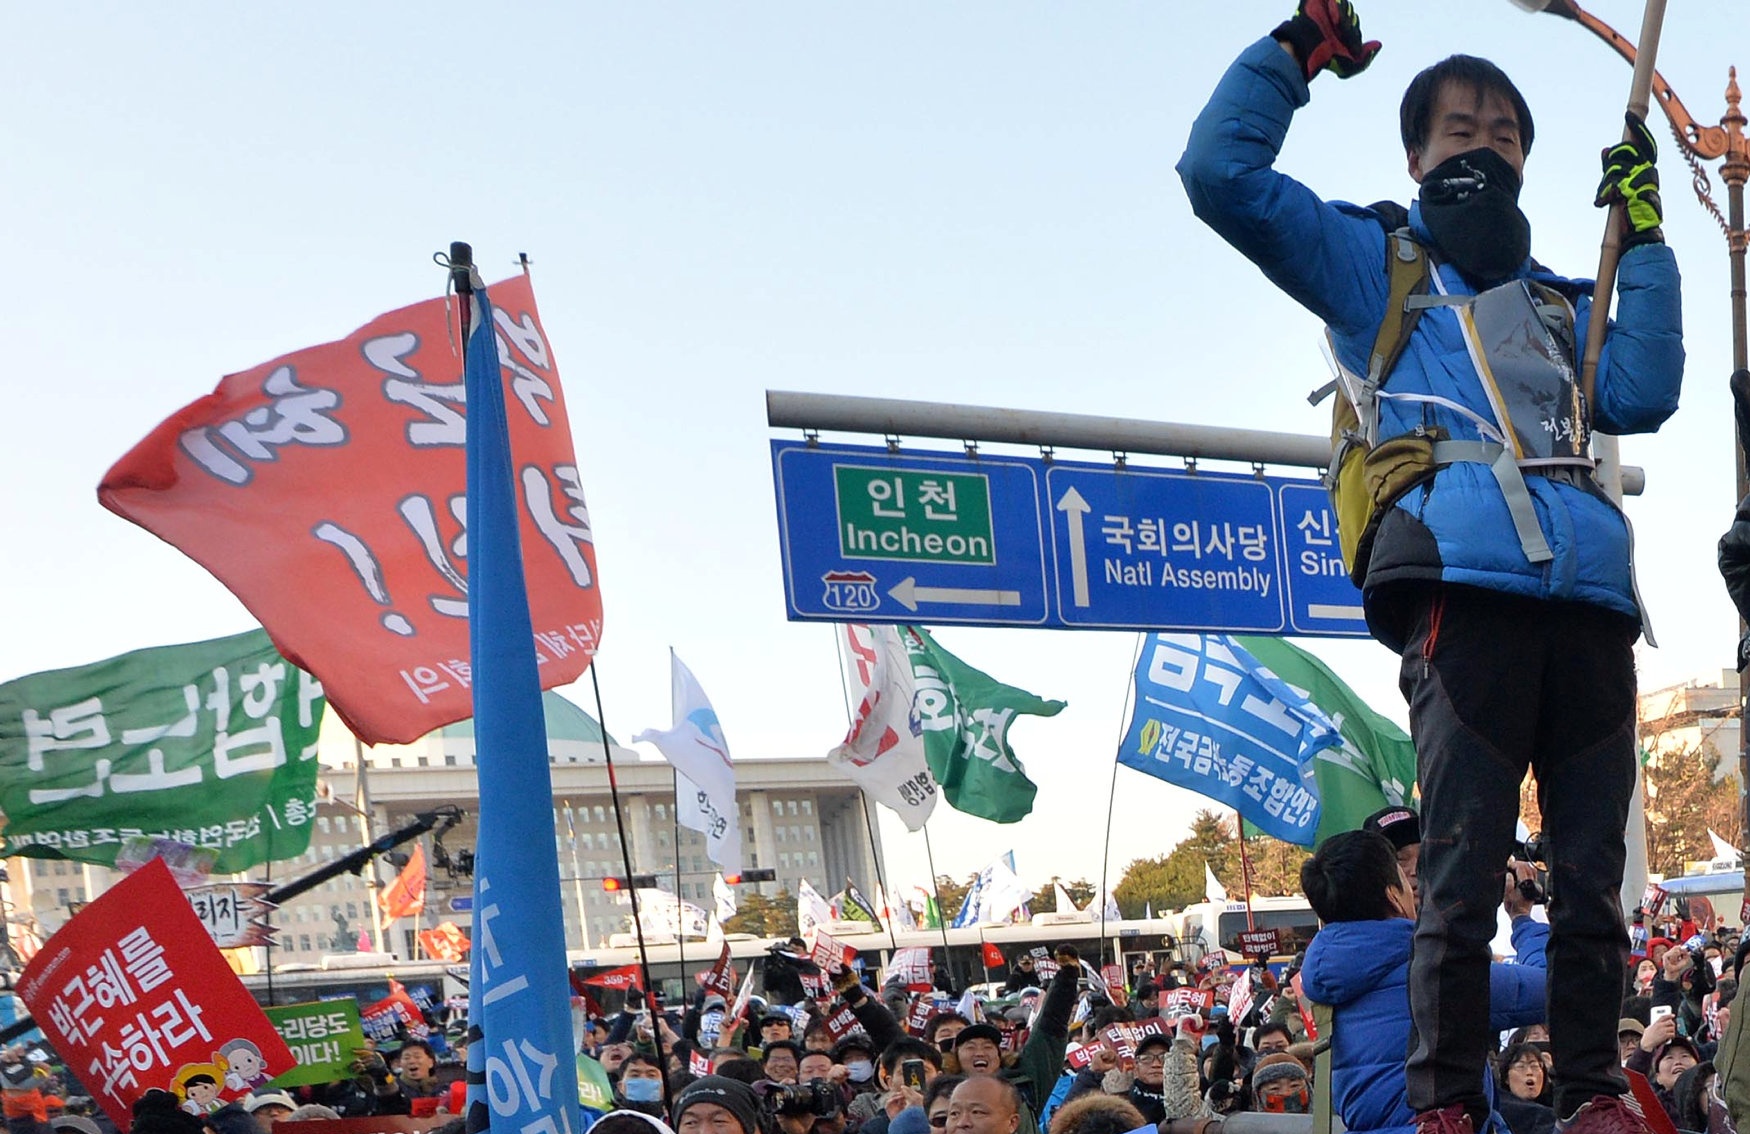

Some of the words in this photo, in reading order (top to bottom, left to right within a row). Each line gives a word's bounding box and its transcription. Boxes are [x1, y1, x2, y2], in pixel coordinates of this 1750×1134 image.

[847, 522, 988, 557] Incheon
[1101, 514, 1268, 562] 국회의사당
[1297, 508, 1341, 547] 신
[830, 584, 871, 608] 120
[1104, 558, 1152, 587] Natl
[1161, 562, 1271, 598] Assembly
[48, 926, 174, 1047] 박근혜를
[88, 988, 213, 1111] 구속하라
